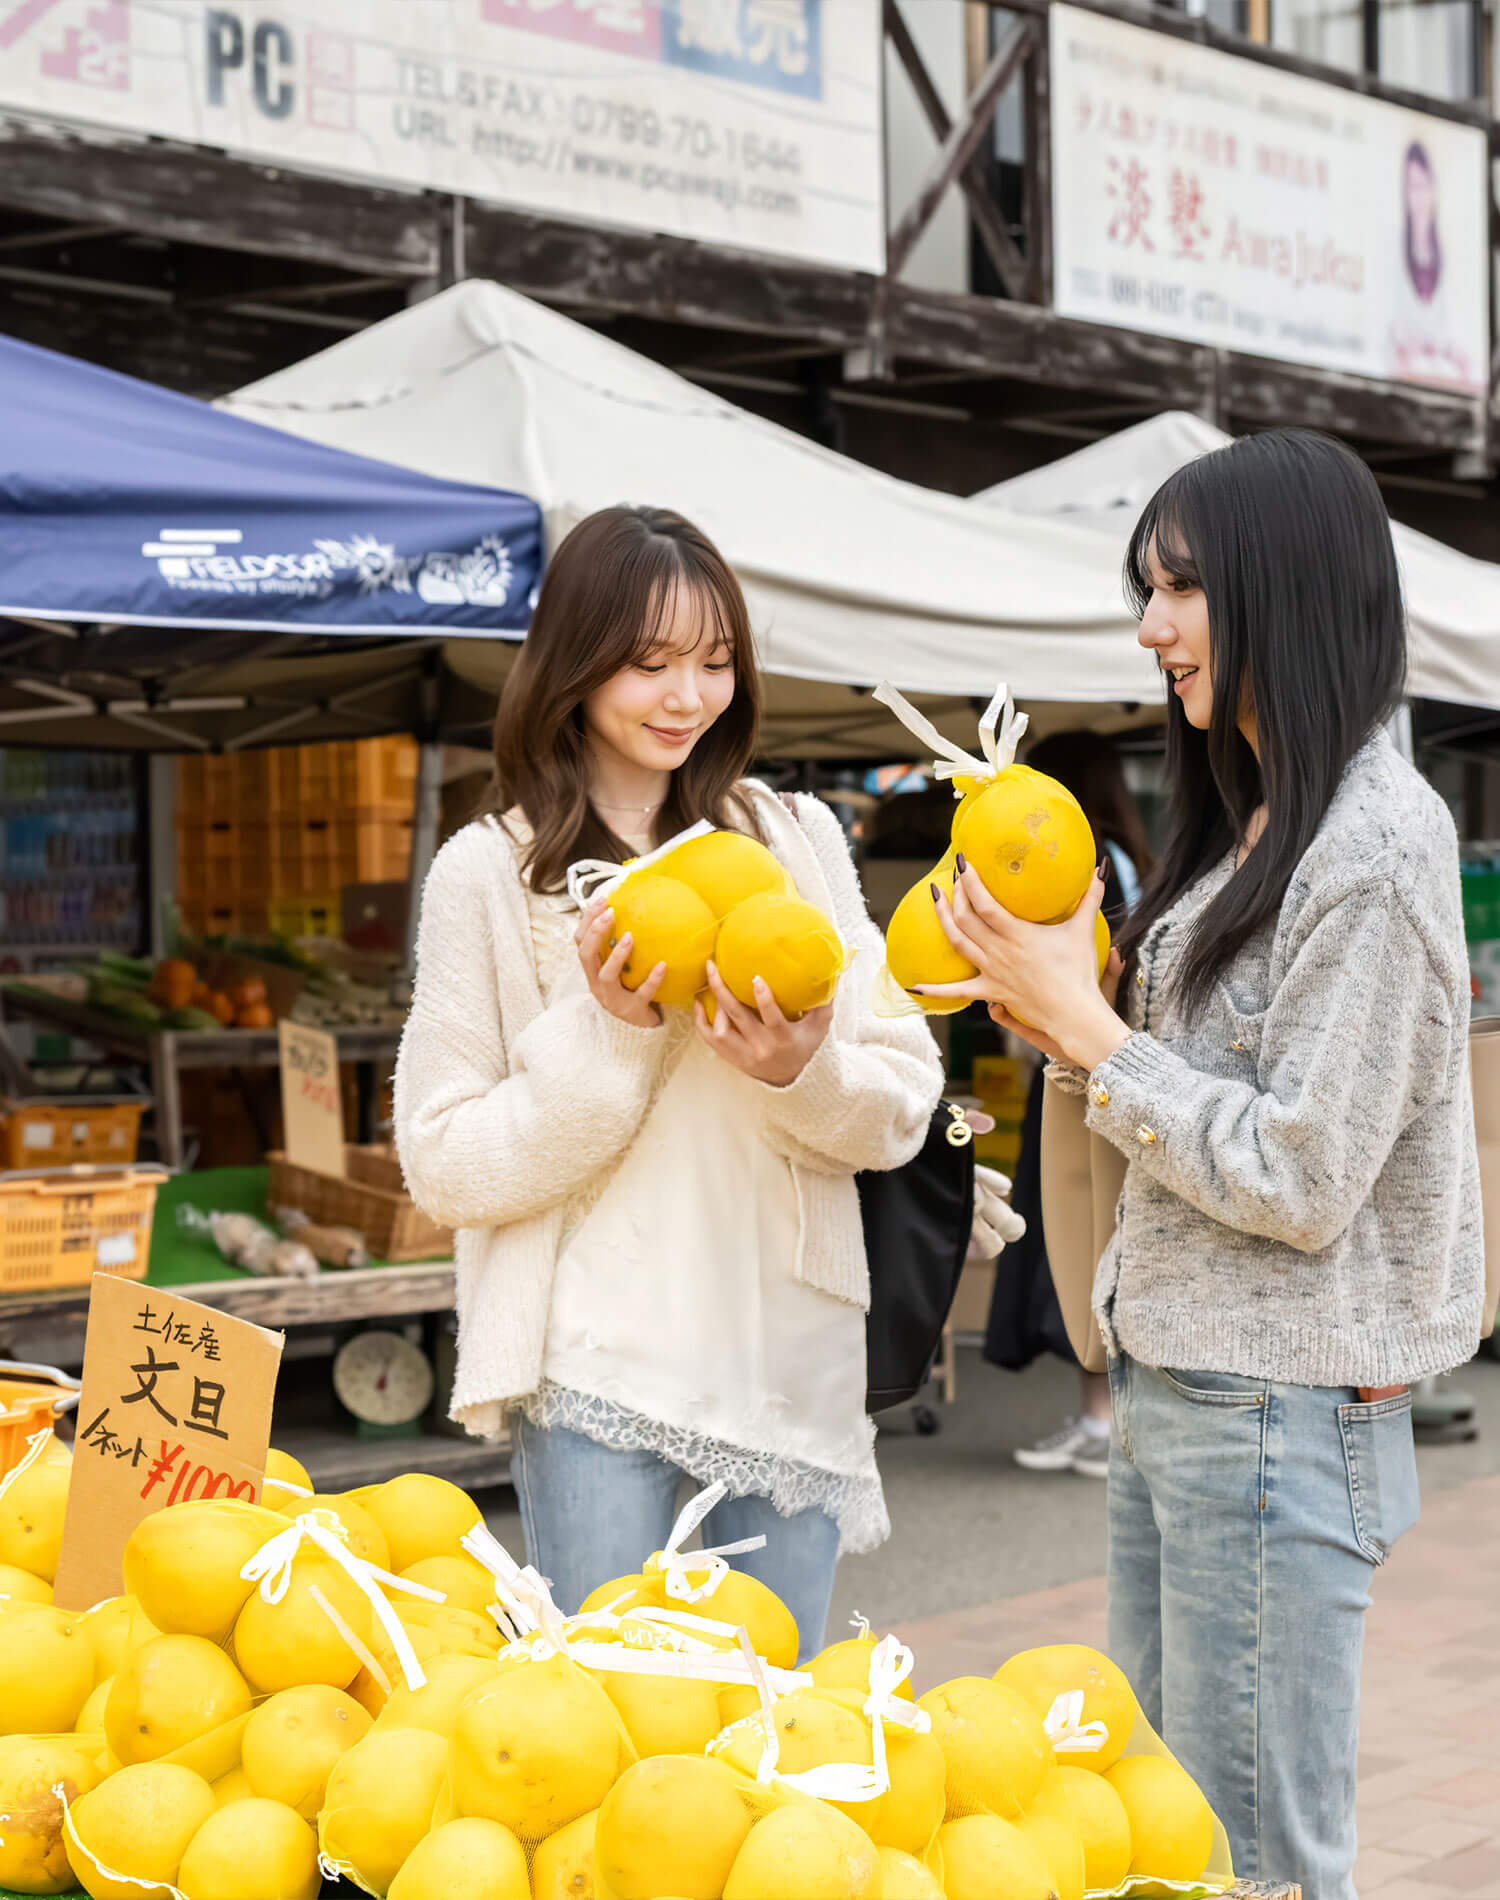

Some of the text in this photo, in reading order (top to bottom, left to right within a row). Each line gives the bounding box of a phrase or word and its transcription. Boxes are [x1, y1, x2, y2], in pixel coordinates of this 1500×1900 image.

[206, 10, 295, 121] PC
[132, 1302, 222, 1362] 土佐産
[120, 1345, 230, 1441] 文旦
